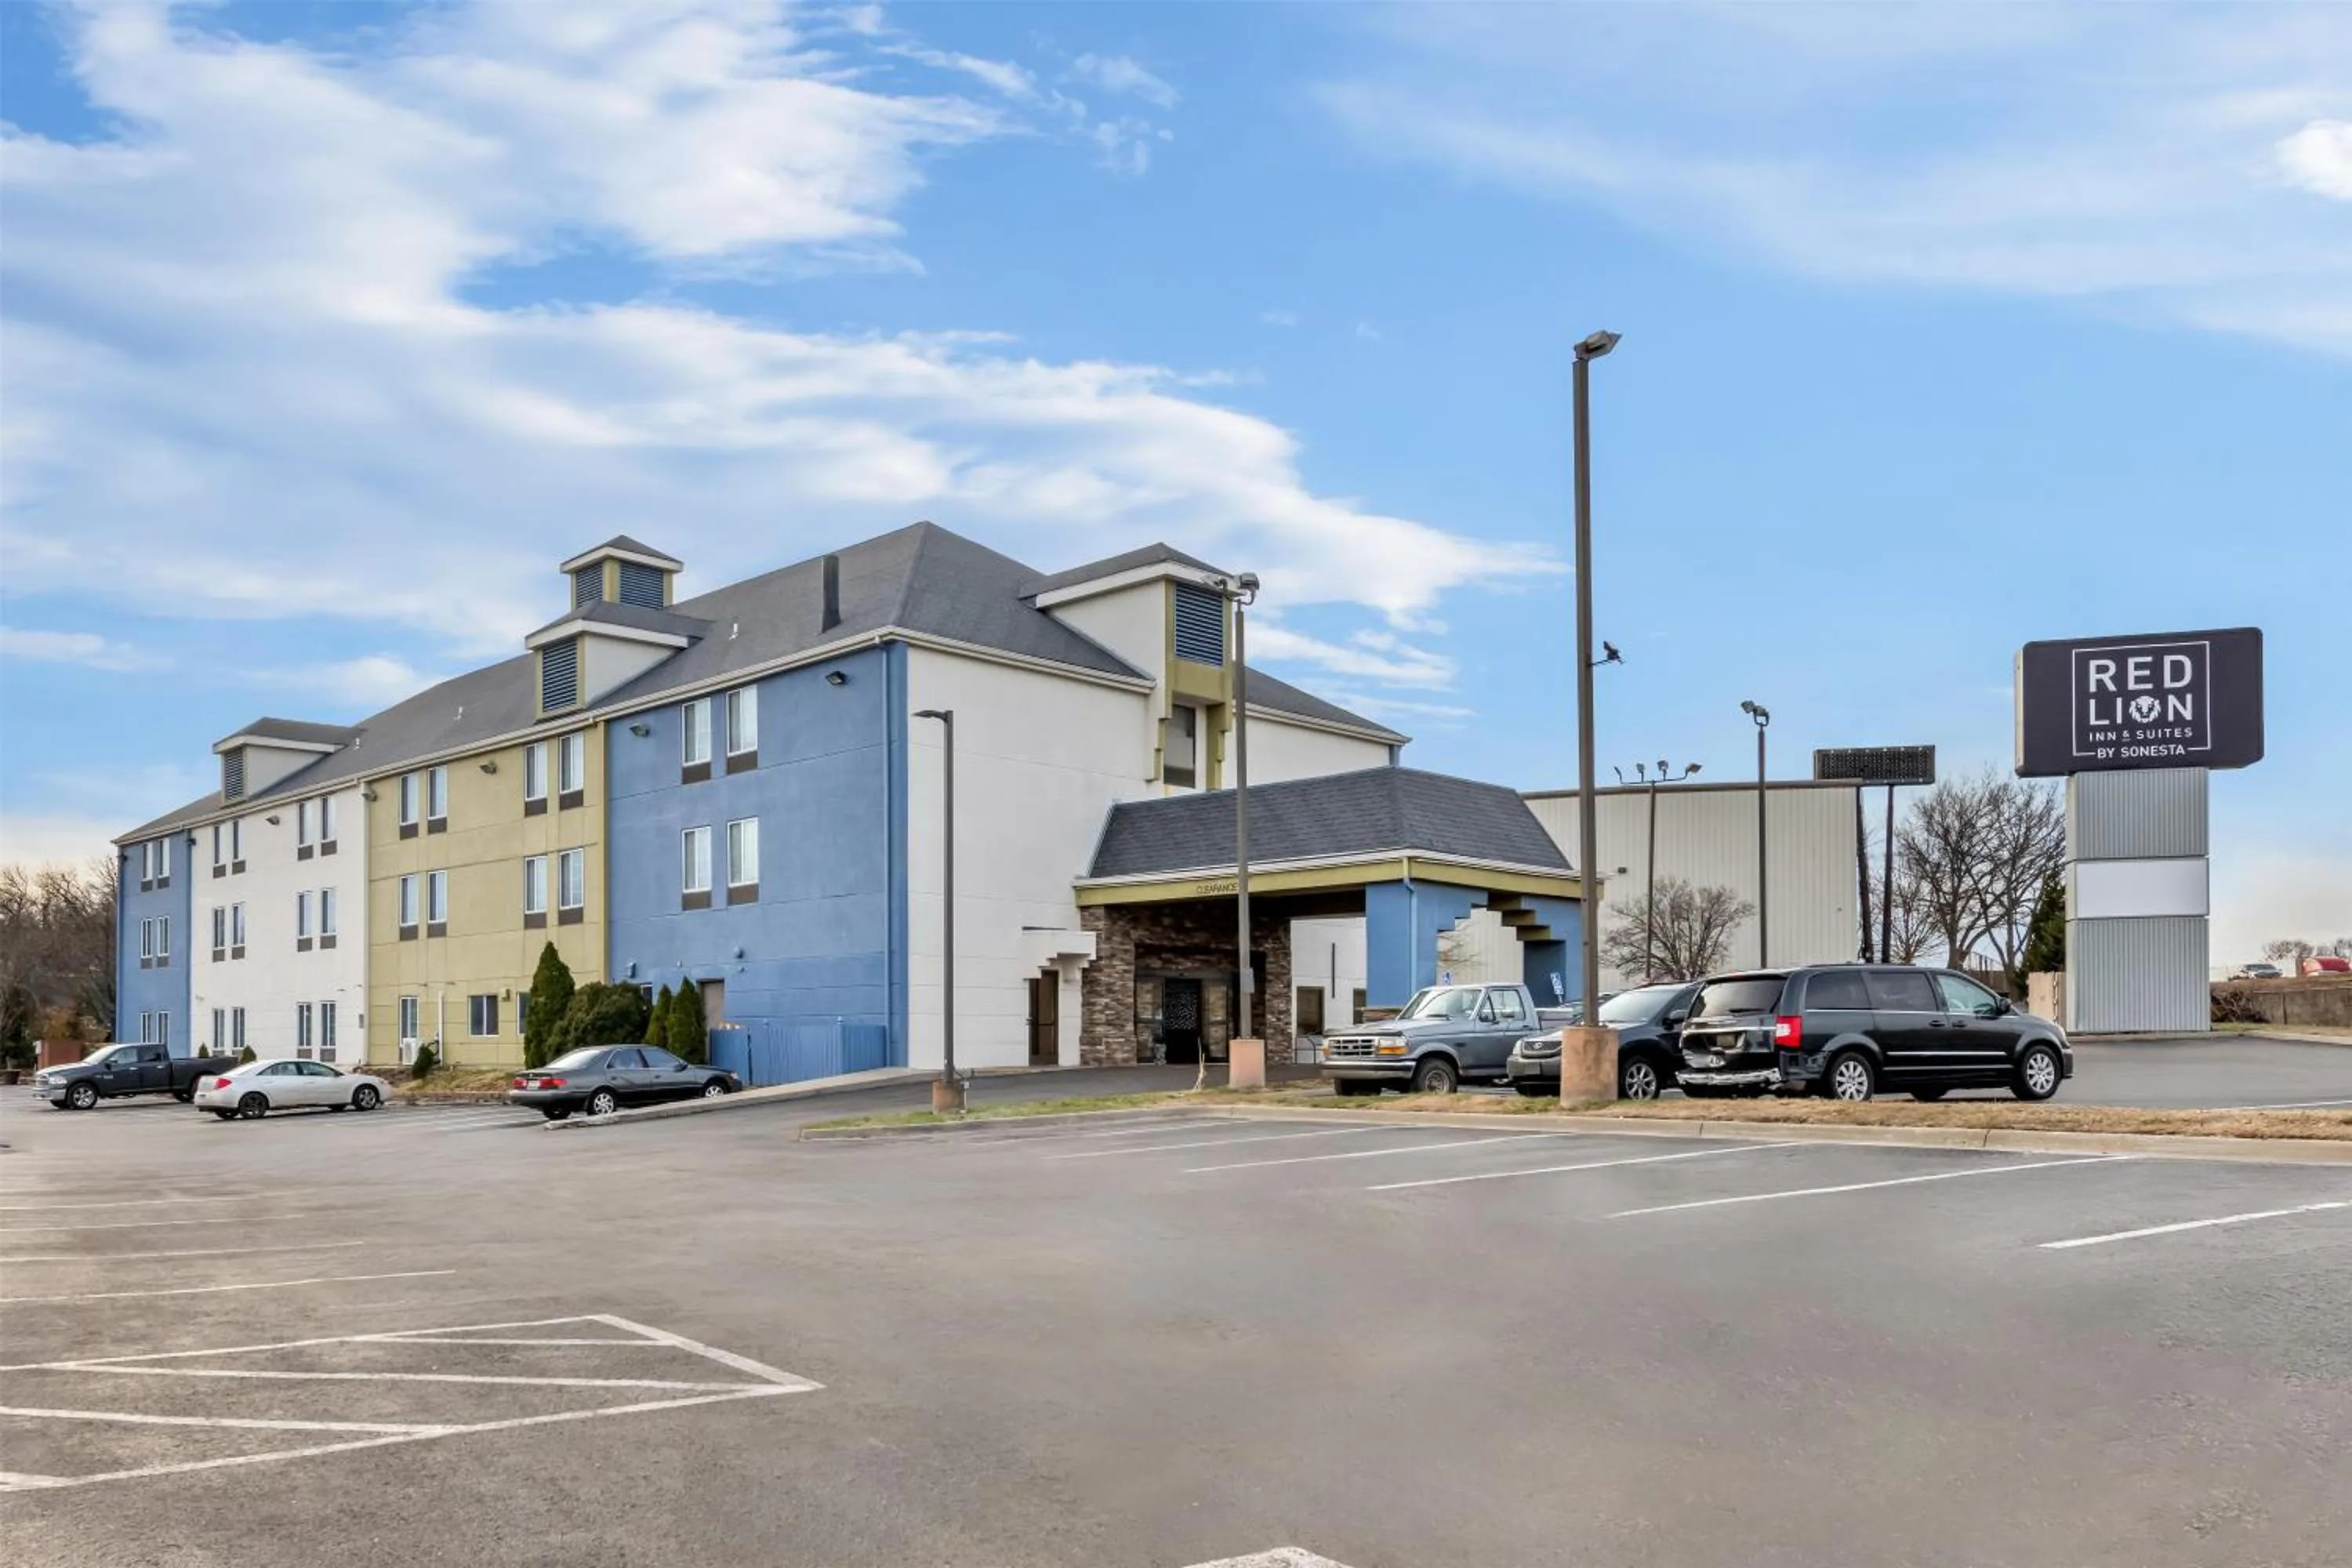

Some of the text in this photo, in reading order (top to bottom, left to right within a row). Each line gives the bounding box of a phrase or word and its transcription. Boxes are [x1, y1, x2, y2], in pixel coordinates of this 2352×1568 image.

[2089, 655, 2193, 692] RED
[2089, 727, 2193, 743] INN & SUITES
[2096, 744, 2186, 759] BY SONESTA
